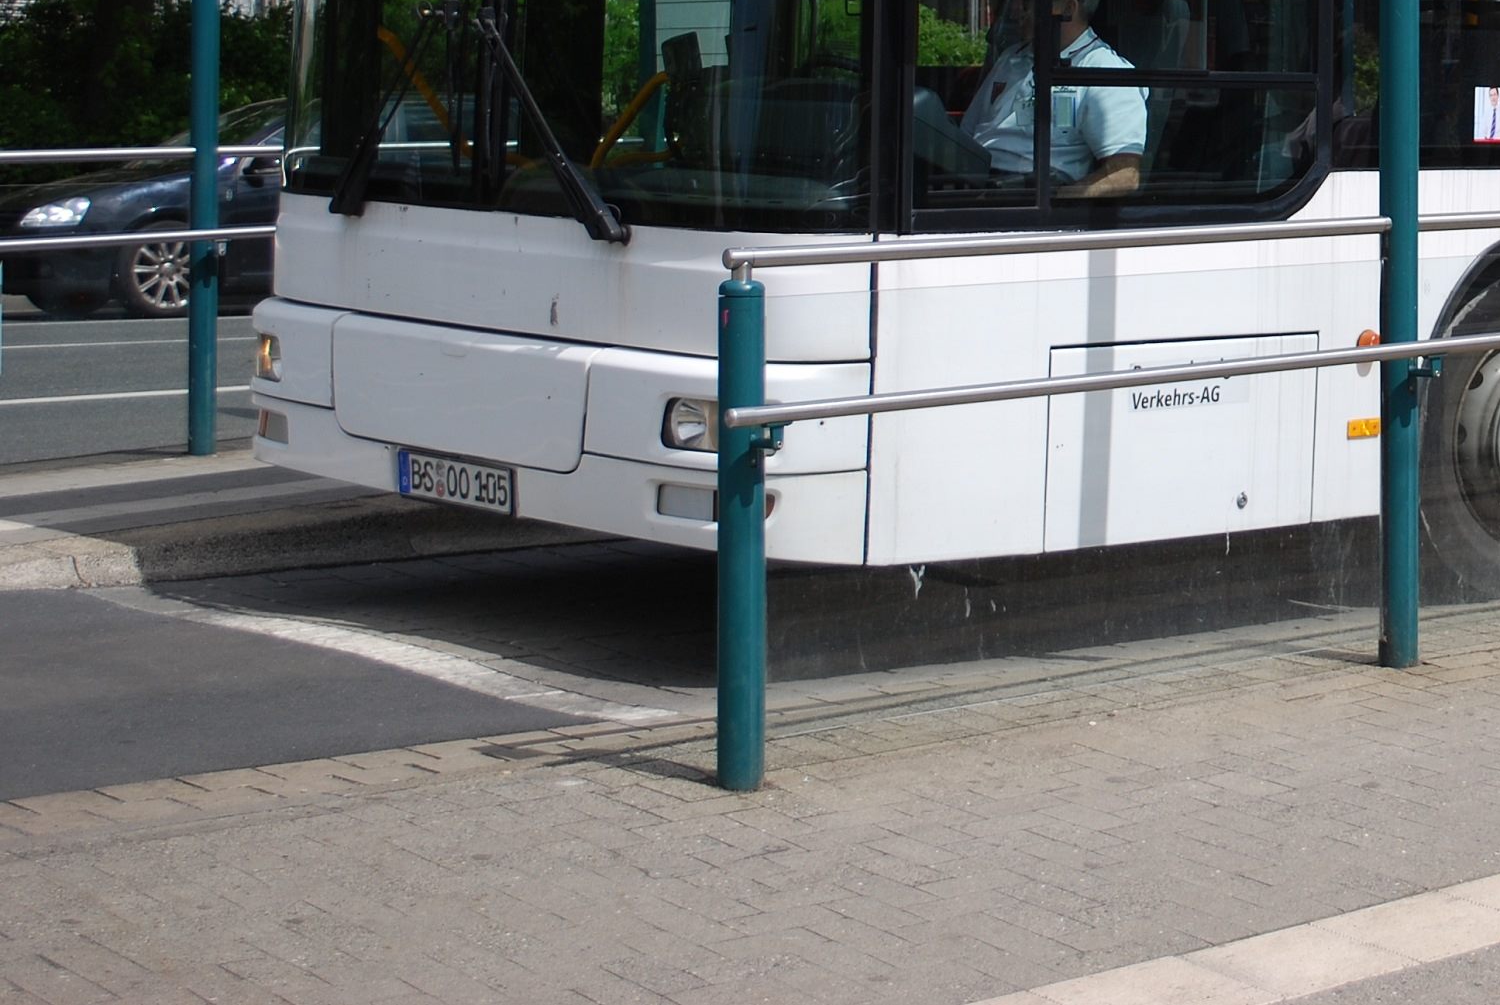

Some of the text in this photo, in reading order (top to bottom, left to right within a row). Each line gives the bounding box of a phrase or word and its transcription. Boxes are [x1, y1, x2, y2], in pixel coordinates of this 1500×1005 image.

[1132, 385, 1221, 410] Verkehrs-AG
[411, 458, 434, 492] BS
[474, 470, 508, 506] 105
